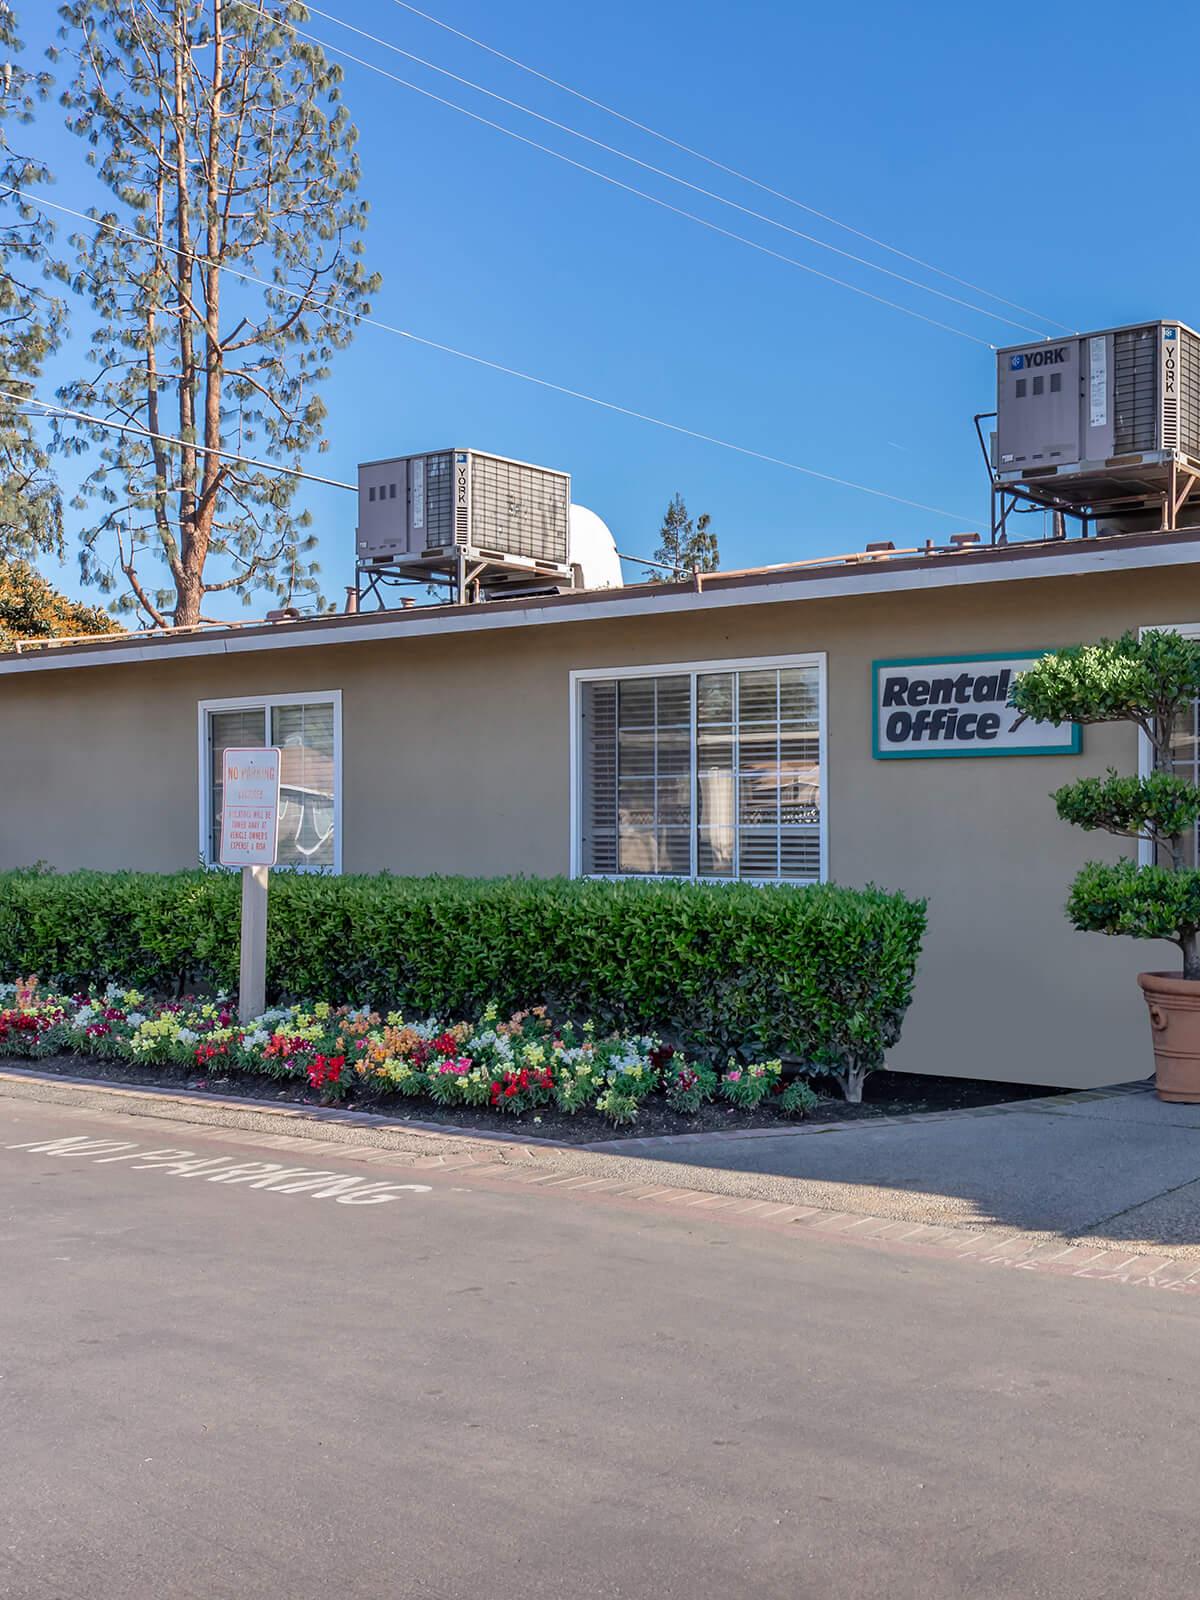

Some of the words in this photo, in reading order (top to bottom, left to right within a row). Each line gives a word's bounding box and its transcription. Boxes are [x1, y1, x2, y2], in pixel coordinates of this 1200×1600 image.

[1023, 347, 1065, 369] YORK
[1165, 347, 1175, 392] YORK
[458, 468, 466, 503] YORK
[882, 669, 1011, 707] Rental
[886, 708, 1001, 742] Office
[228, 767, 238, 780] NO
[241, 767, 275, 781] PARKING
[5, 1136, 140, 1157] NO
[92, 1149, 433, 1205] PARKING
